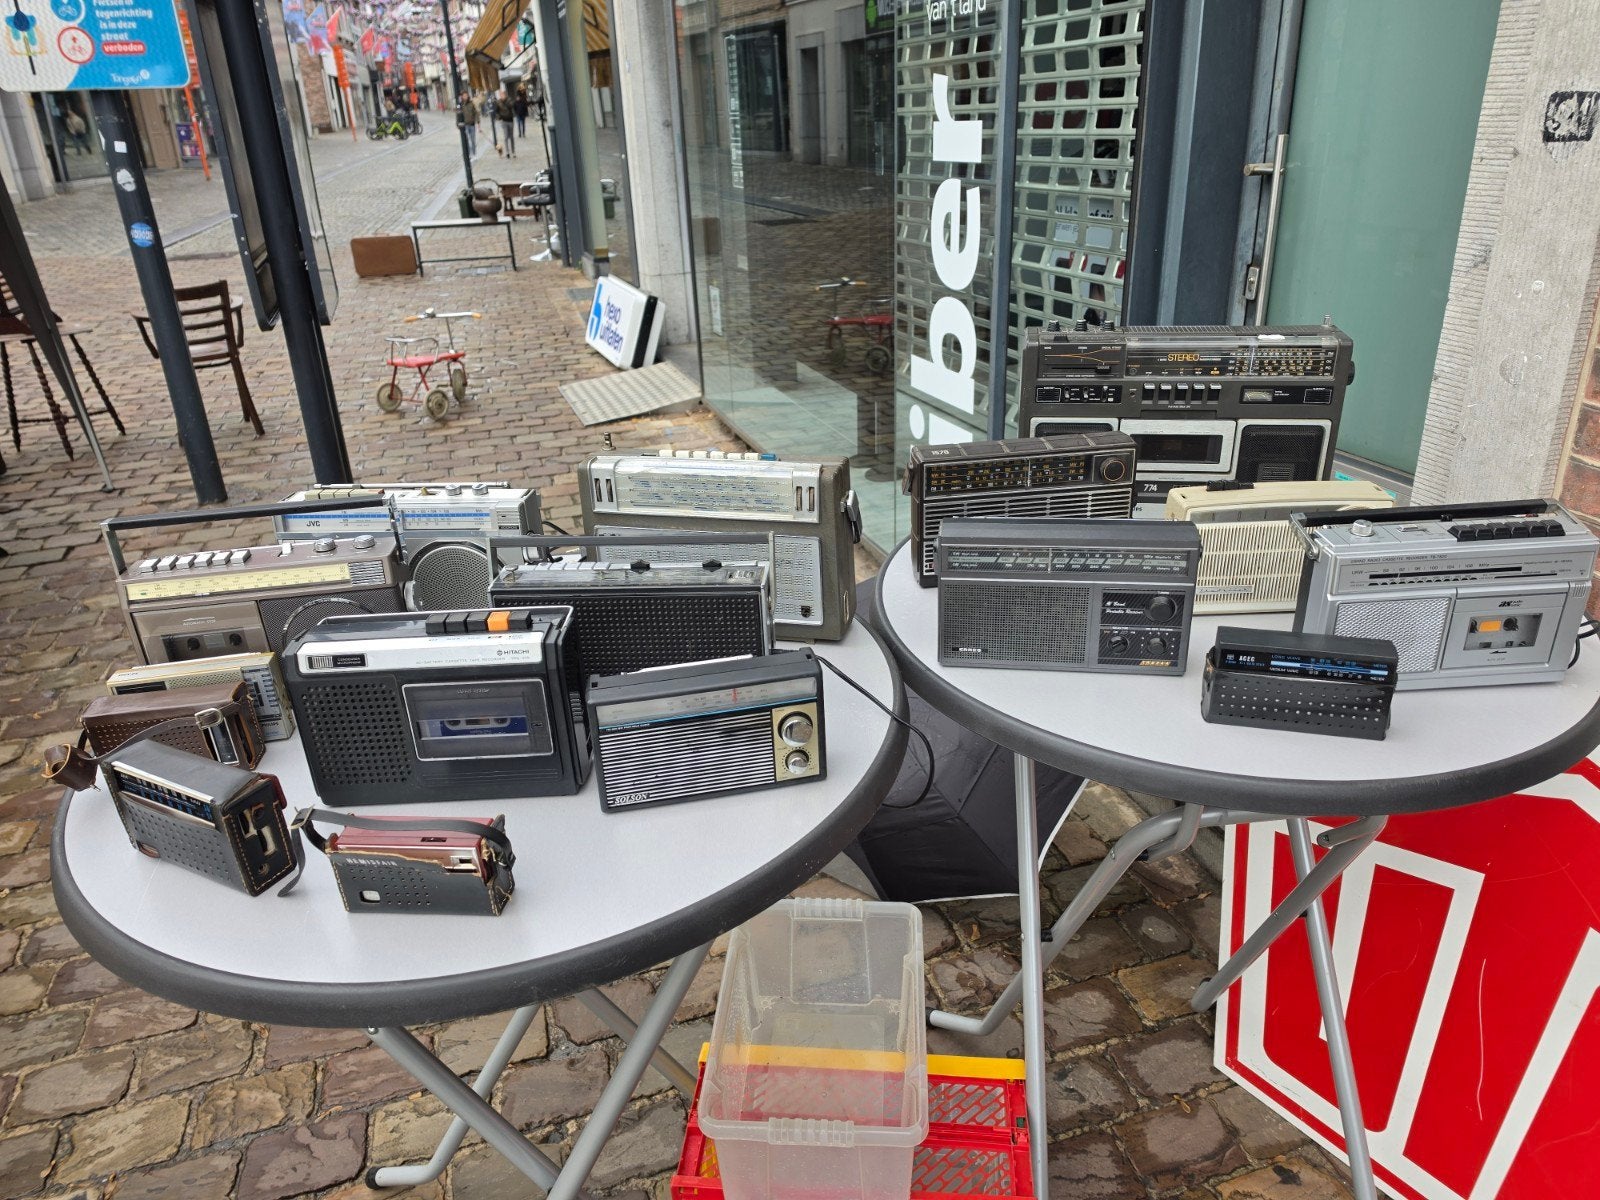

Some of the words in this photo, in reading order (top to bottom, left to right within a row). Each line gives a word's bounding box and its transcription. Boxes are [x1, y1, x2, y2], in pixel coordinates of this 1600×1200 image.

[95, 8, 153, 19] tegenrichting
[926, 0, 947, 20] van
[101, 33, 129, 41] straat
[103, 43, 143, 53] verboden
[1167, 353, 1200, 362] STEREO
[1143, 483, 1158, 492] 774
[614, 793, 649, 804] SOLSON
